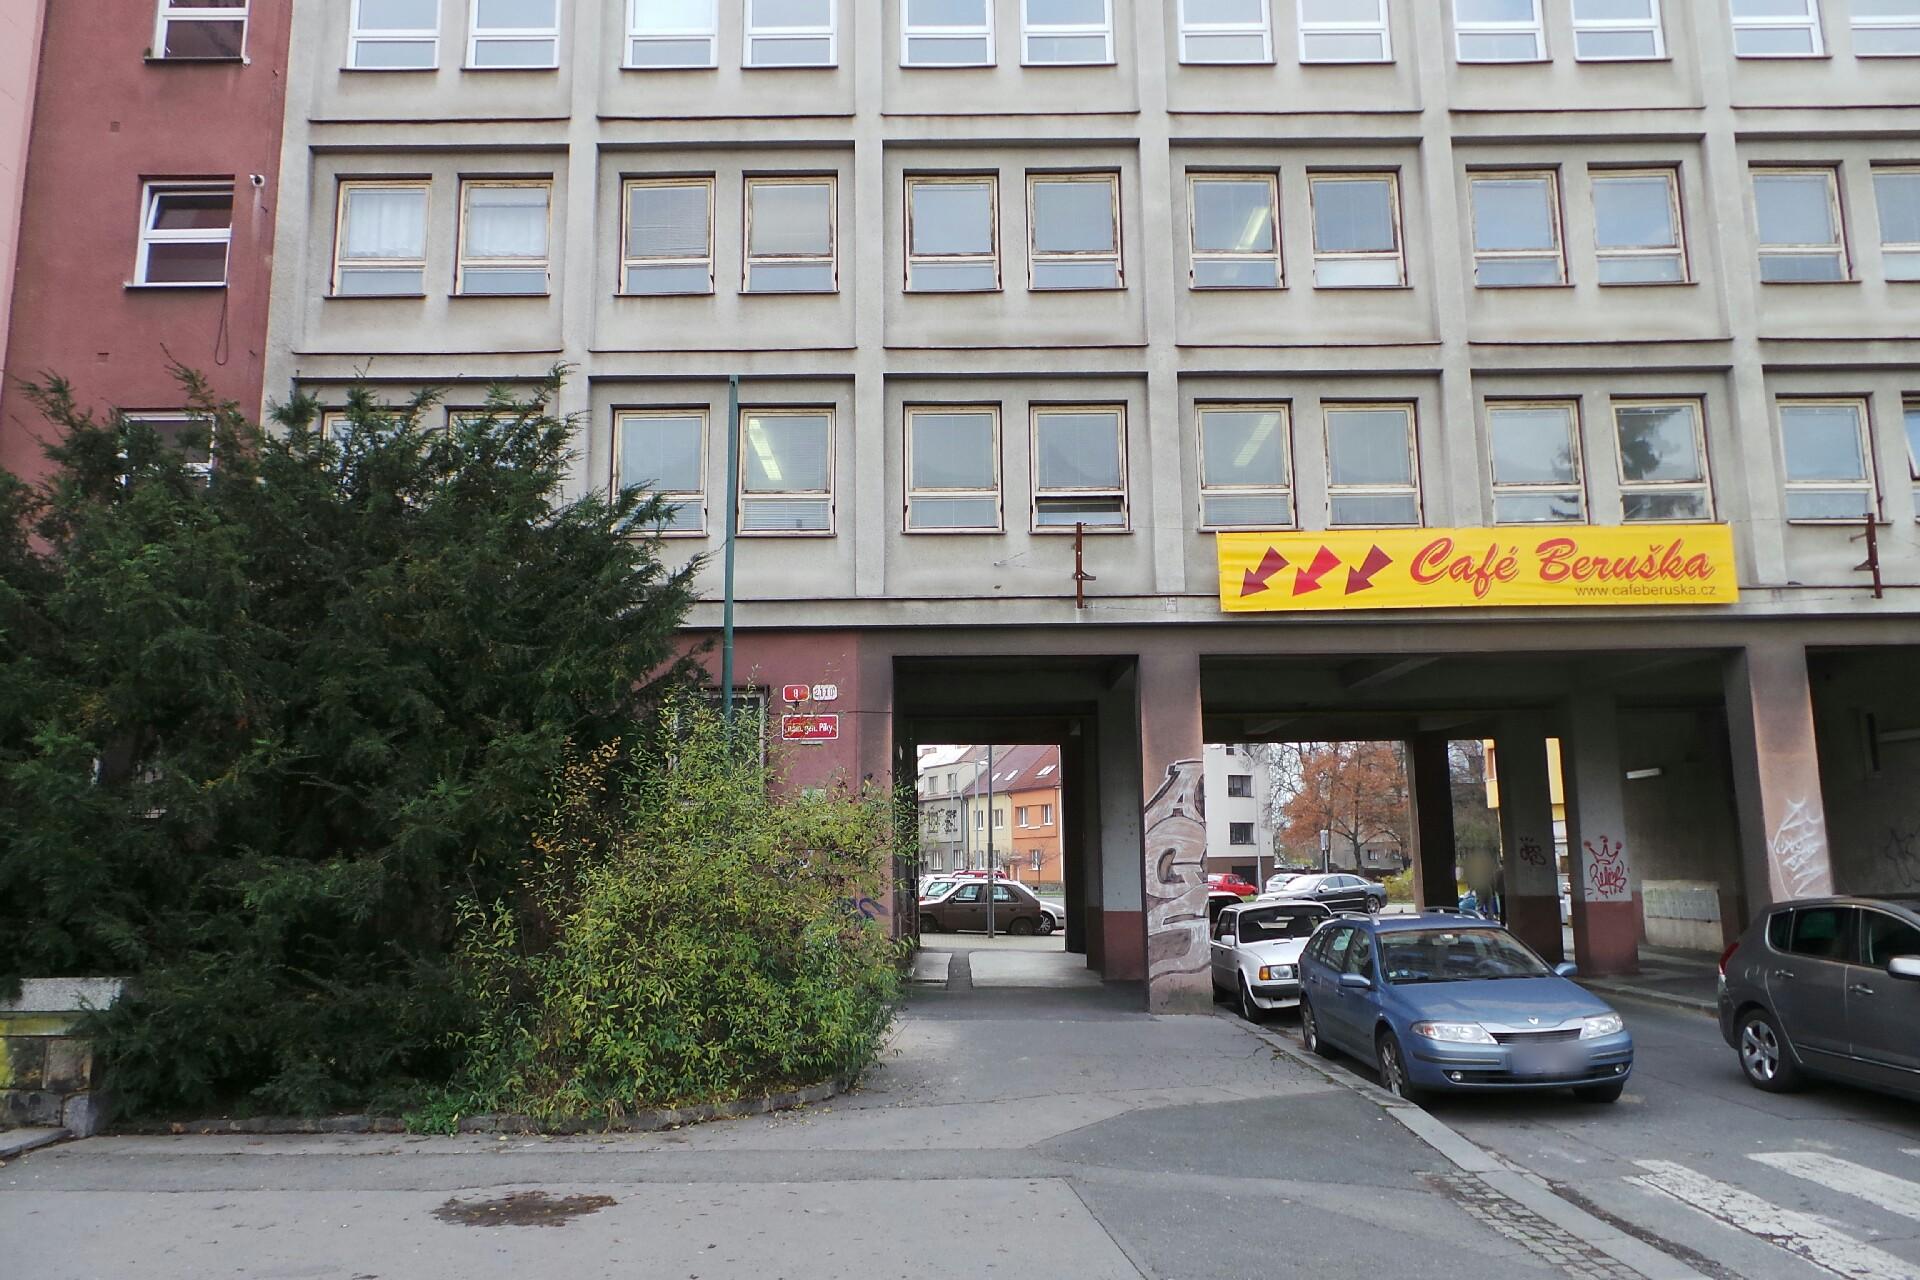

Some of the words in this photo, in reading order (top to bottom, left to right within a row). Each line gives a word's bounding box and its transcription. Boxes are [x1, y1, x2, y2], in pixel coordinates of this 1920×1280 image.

[1410, 537, 1519, 599] Café
[1536, 537, 1715, 583] Beruška
[1575, 583, 1716, 597] www.cafeberuska.cz
